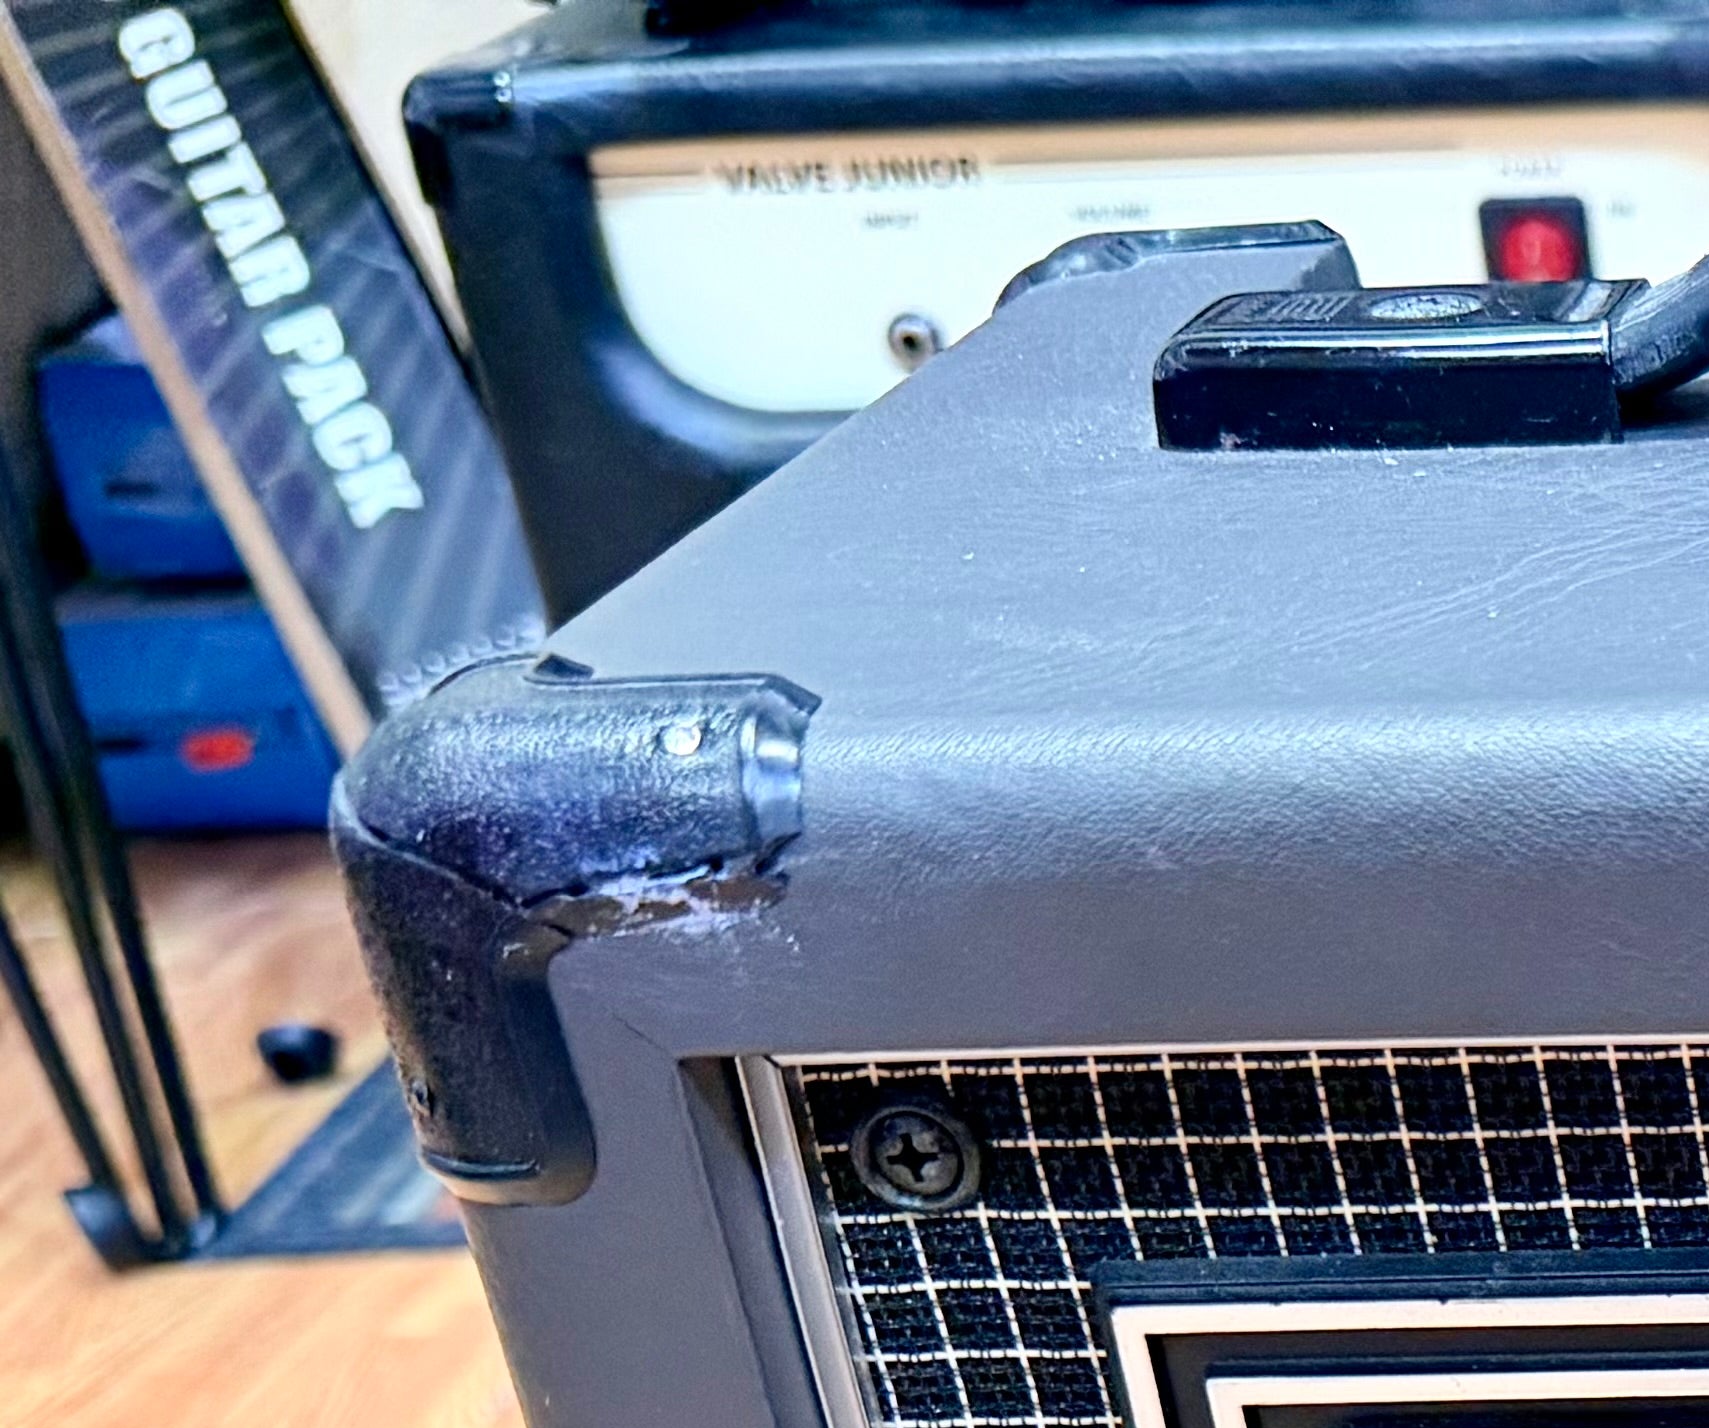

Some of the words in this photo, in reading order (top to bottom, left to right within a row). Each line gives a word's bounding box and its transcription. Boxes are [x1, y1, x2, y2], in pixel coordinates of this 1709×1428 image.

[117, 7, 311, 308] GUITAR
[262, 304, 425, 530] PACK
[715, 160, 833, 195] VALVE
[846, 153, 981, 191] JUNIOR
